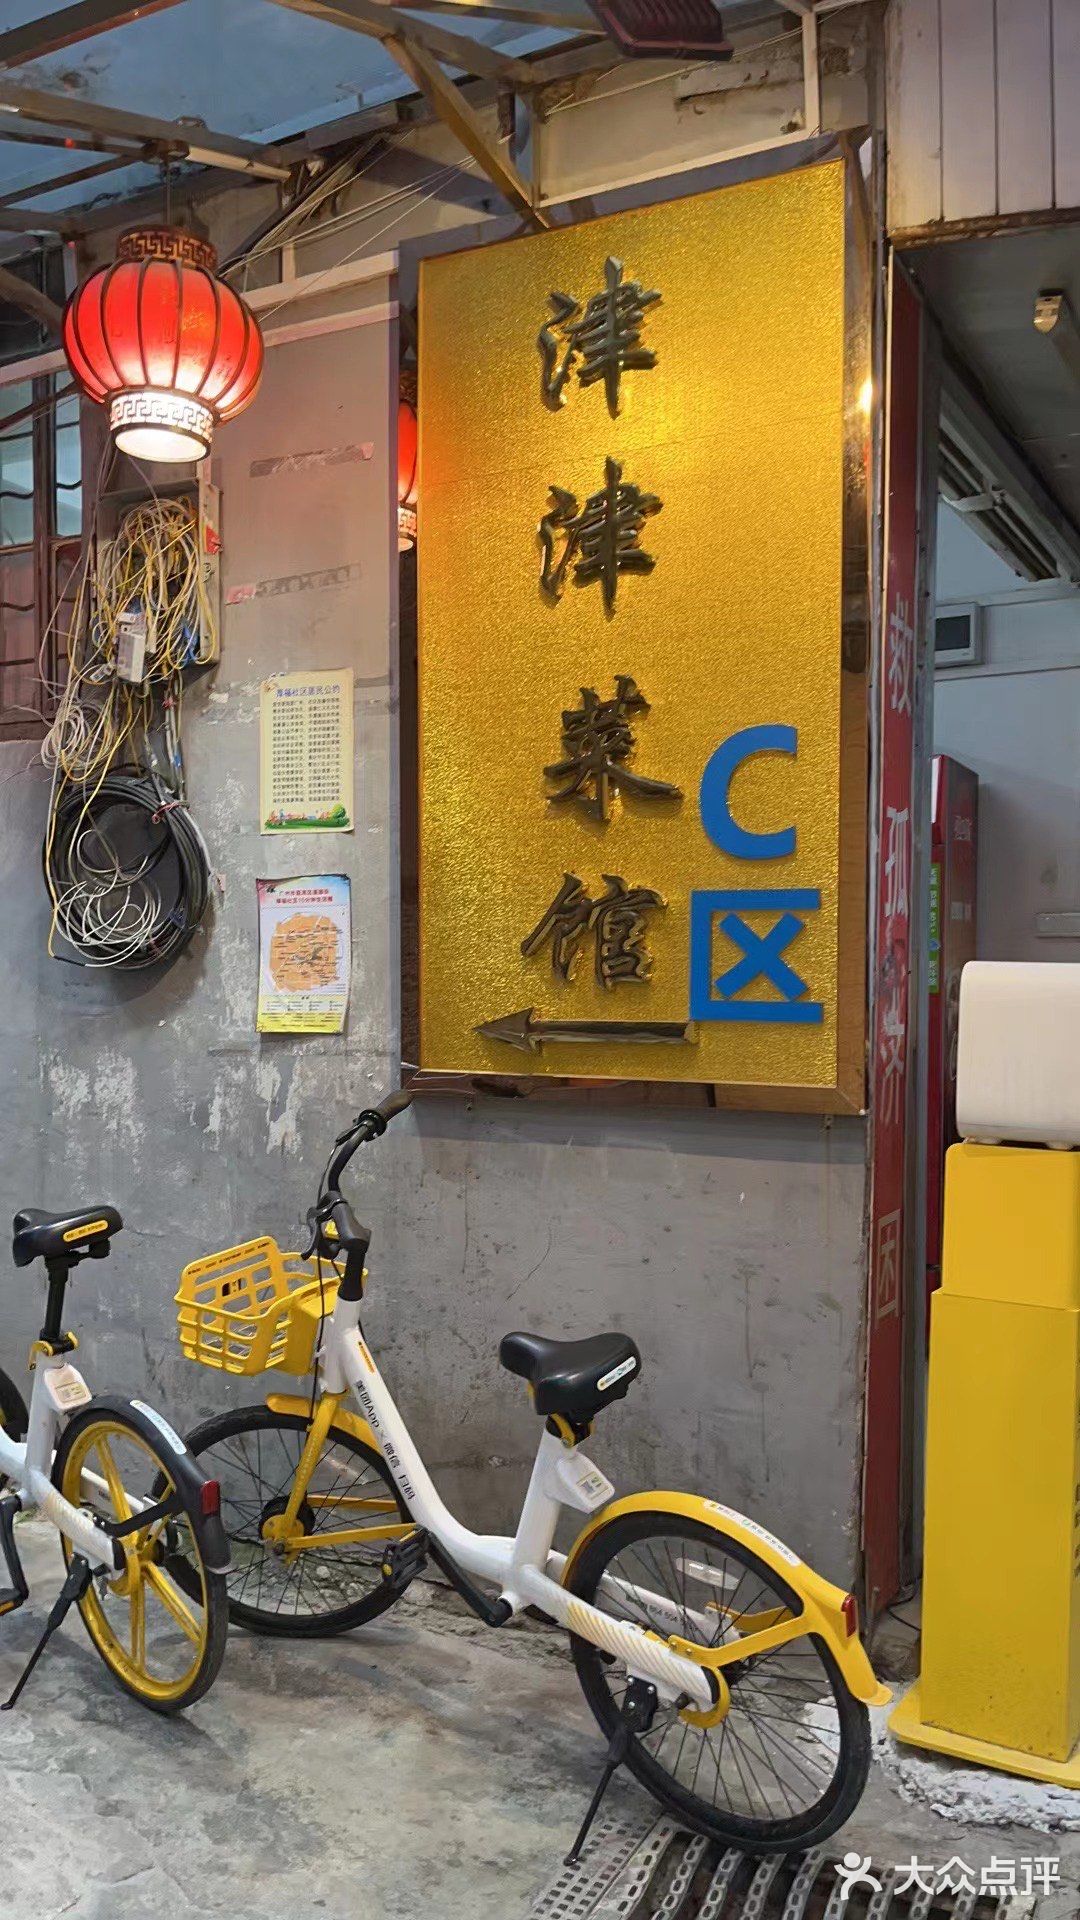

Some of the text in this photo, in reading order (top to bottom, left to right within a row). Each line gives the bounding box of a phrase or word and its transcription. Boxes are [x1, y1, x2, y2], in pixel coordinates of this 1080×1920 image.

[520, 256, 684, 991] 津津菜馆
[690, 723, 823, 1025] C区
